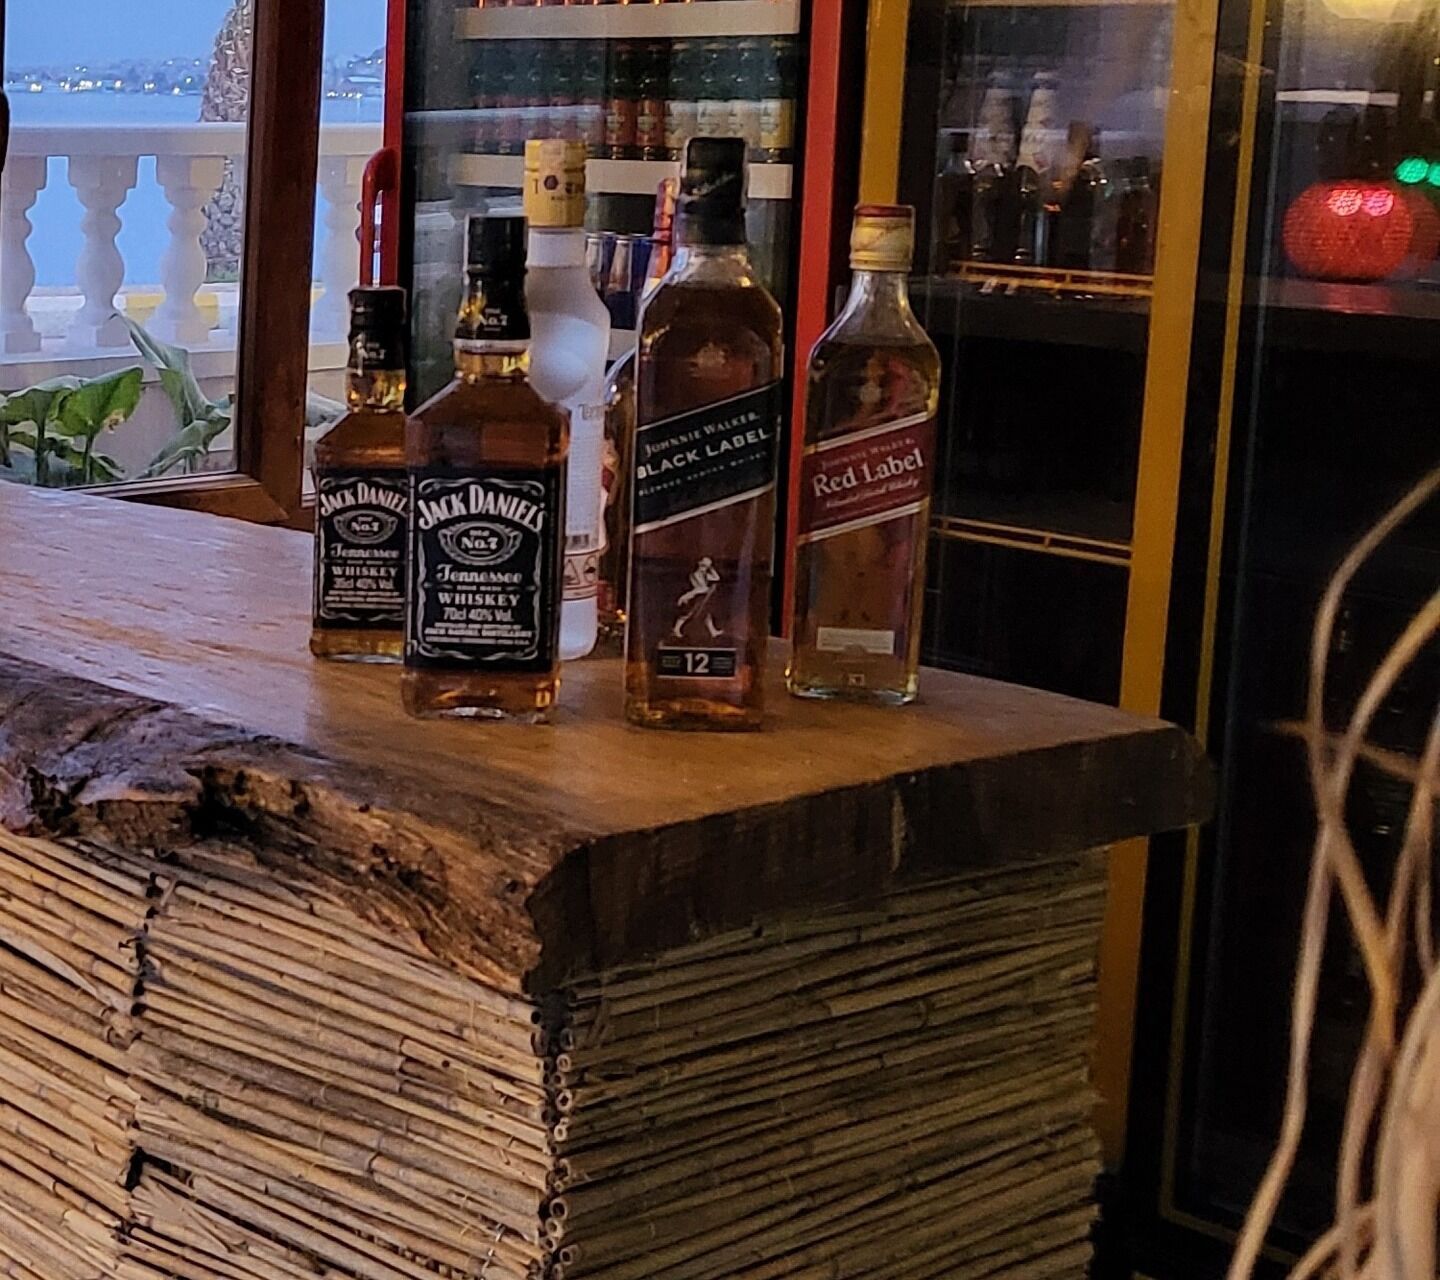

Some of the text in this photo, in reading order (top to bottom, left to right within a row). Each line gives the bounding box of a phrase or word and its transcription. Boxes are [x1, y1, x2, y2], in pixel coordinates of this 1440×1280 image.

[645, 411, 759, 458] JOHNNIE WALKER
[637, 449, 701, 480] BLACK
[705, 428, 772, 457] LABEL
[813, 466, 858, 497] Red
[863, 447, 925, 483] Label
[320, 482, 408, 517] JACK DANIEL
[417, 492, 467, 530] JACK
[469, 484, 547, 532] DANIEL'S
[331, 565, 398, 577] WHISKEY
[436, 563, 523, 583] Tennessee
[438, 592, 521, 607] WHISKEY
[684, 652, 710, 674] 12
